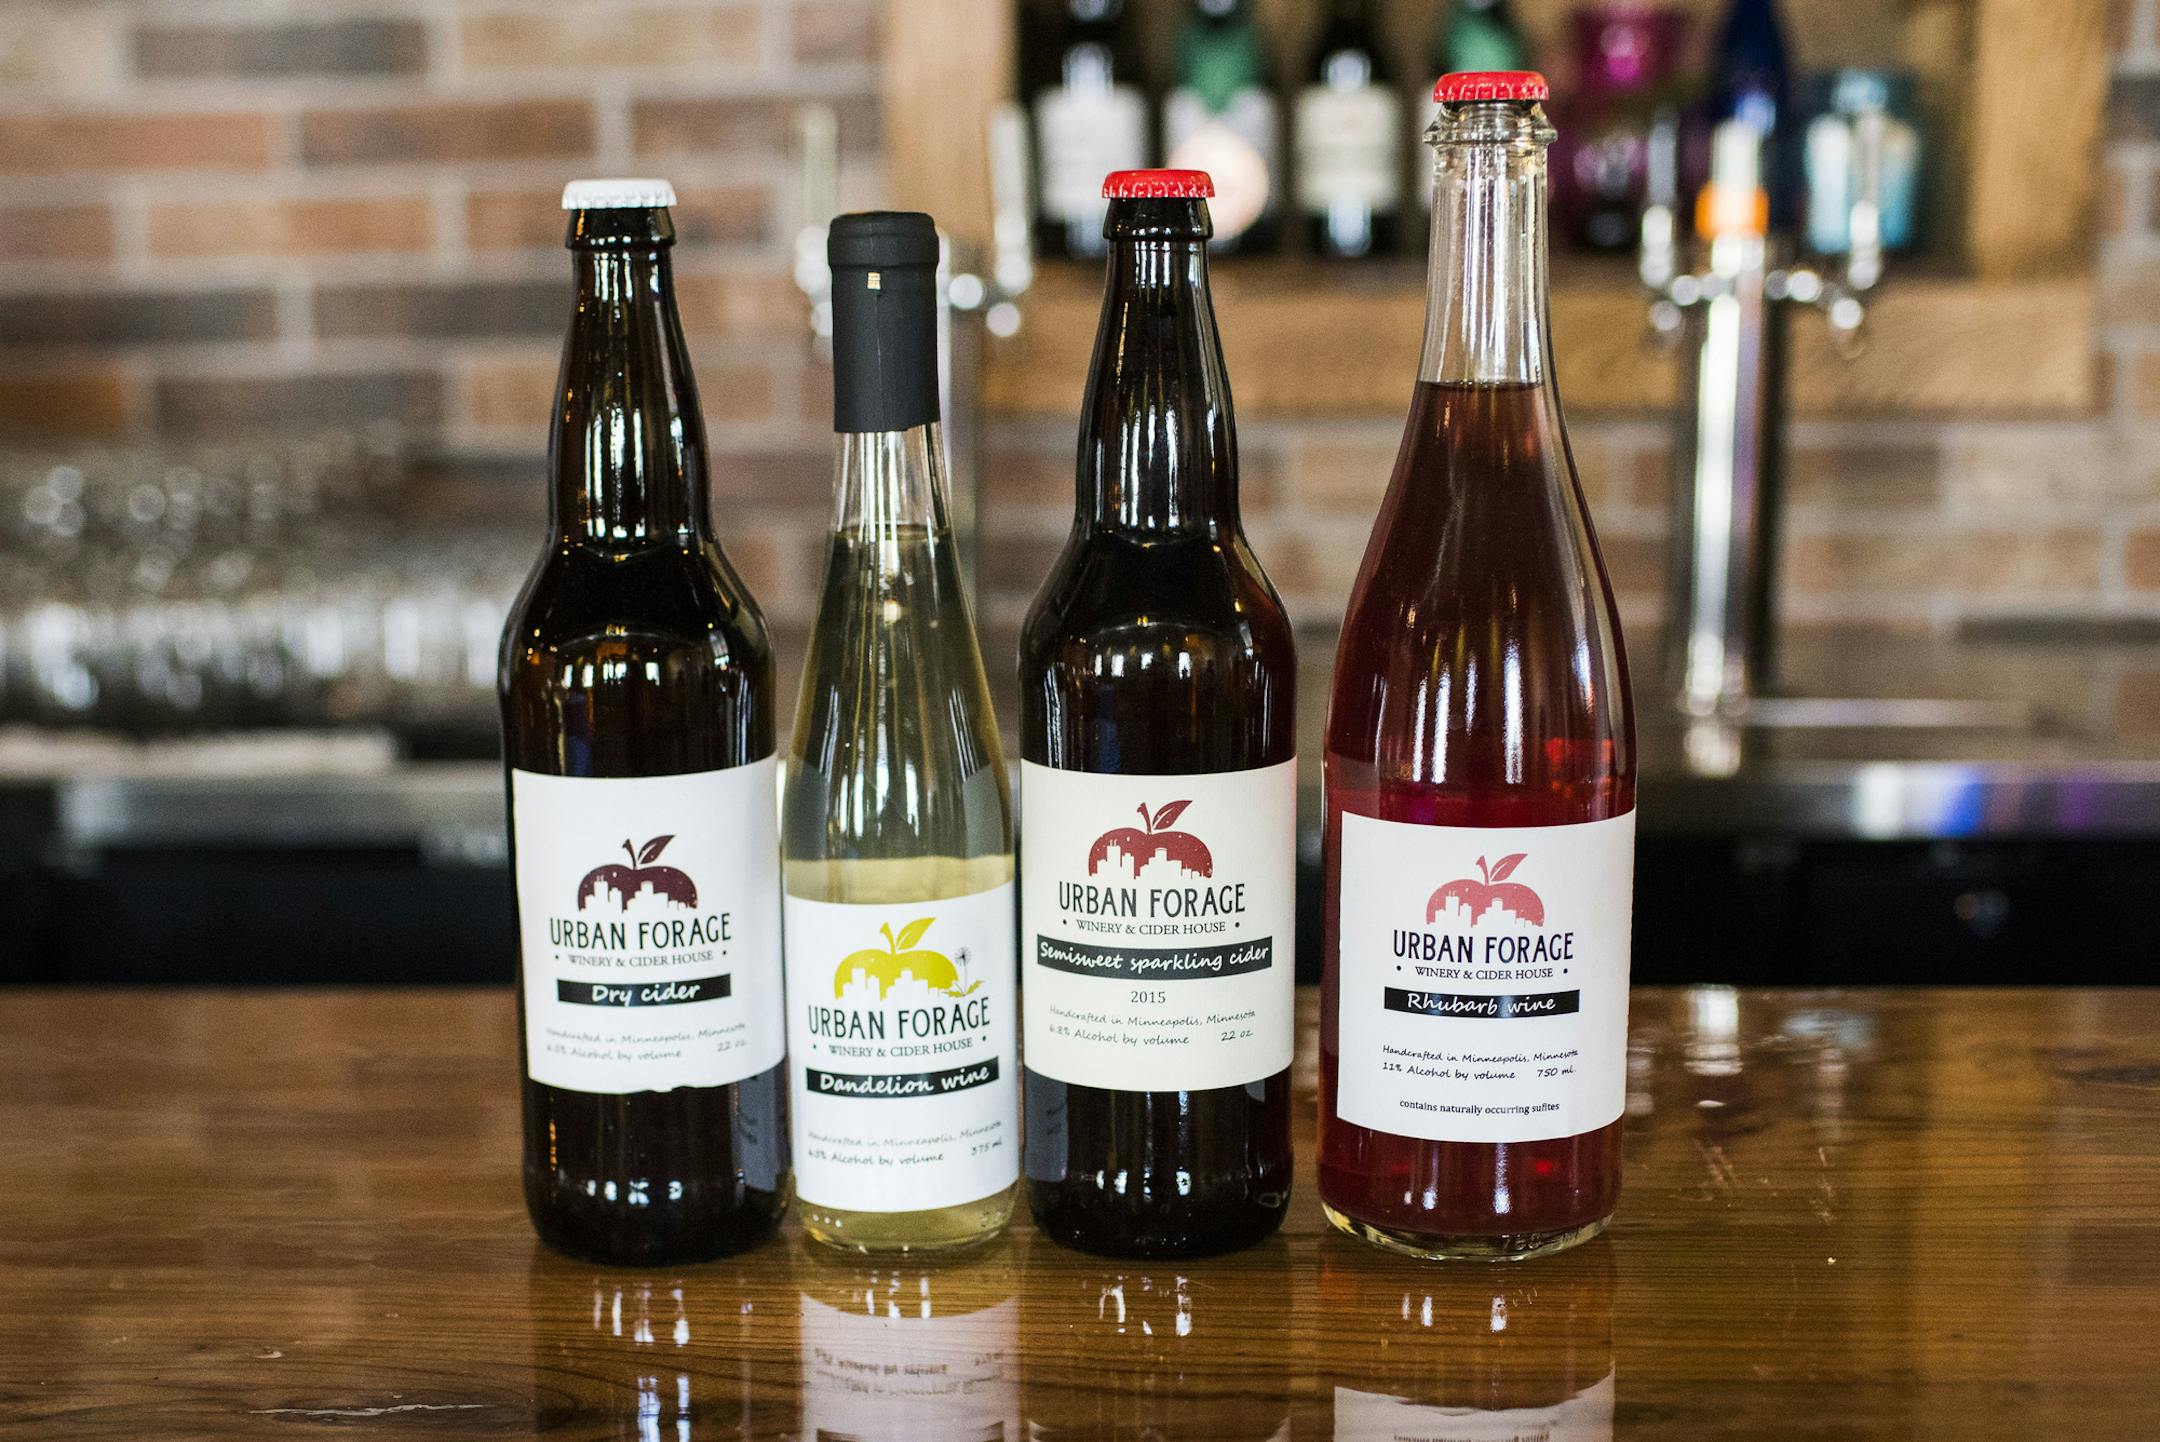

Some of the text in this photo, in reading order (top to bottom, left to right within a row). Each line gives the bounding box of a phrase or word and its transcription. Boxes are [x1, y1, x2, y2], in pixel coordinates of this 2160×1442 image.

[1059, 881, 1245, 917] URBAN FORAGE
[550, 912, 731, 950] URBAN FORAGE
[1076, 919, 1226, 935] WINERY & CIDER HOUSE
[1393, 929, 1574, 964] URBAN FORAGE
[568, 950, 713, 968] WINERY & CIDER HOUSE
[1040, 941, 1268, 974] Semisweet sparkling cider
[1415, 966, 1554, 980] WINERY & CIDER HOUSE
[591, 982, 701, 1007] Dry cider
[1130, 991, 1166, 1003] 2015
[1407, 992, 1556, 1015] Rhubarb wine
[808, 996, 990, 1040] URBAN FORAGE
[1049, 1005, 1255, 1028] Handcrafted in Minneapolis, Minnesota
[1074, 1029, 1118, 1043] Alcohol
[1122, 1034, 1137, 1047] by
[1143, 1036, 1190, 1045] volume
[1220, 1031, 1236, 1041] 22
[571, 1048, 612, 1061] Alcohol
[617, 1050, 632, 1062] by
[638, 1050, 682, 1061] volume
[828, 1038, 973, 1058] WINERY & CIDER HOUSE
[1382, 1045, 1579, 1064] Handcrafted in Minneapolis, Minnesota
[1382, 1062, 1516, 1080] 11% Alcohol by volume
[1537, 1067, 1559, 1078] 750
[819, 1065, 990, 1096] Dandelion wine
[1400, 1100, 1438, 1111] contains
[1439, 1105, 1483, 1116] naturally
[1485, 1105, 1530, 1116] occurring
[831, 1153, 874, 1166] Alcohol
[878, 1155, 893, 1167] by
[899, 1152, 944, 1166] volume
